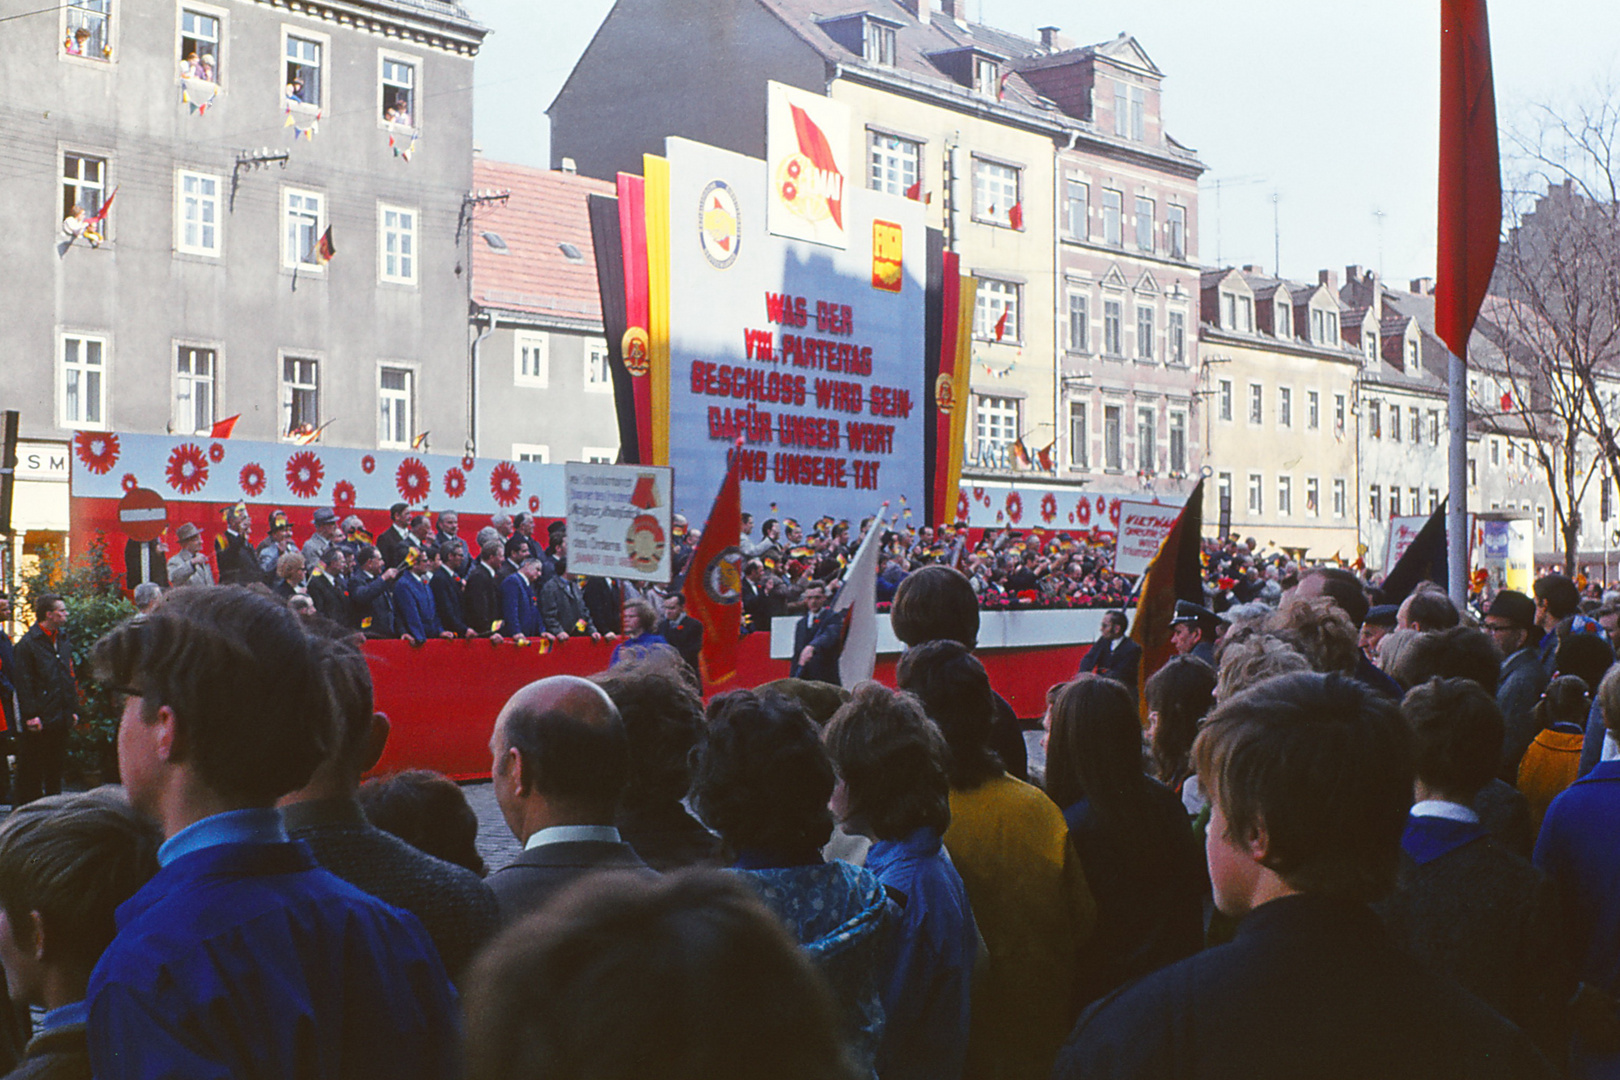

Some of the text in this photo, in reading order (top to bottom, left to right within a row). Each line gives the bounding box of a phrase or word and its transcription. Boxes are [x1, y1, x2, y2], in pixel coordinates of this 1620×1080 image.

[766, 291, 853, 334] WAS DER
[782, 334, 872, 376] PARTEITAG
[691, 360, 806, 405] BESCHLOSS
[815, 377, 863, 413] WIRD
[708, 402, 895, 454] DAFÜR UNSER WORT
[774, 452, 847, 488] UNSERE
[853, 460, 880, 490] TAT
